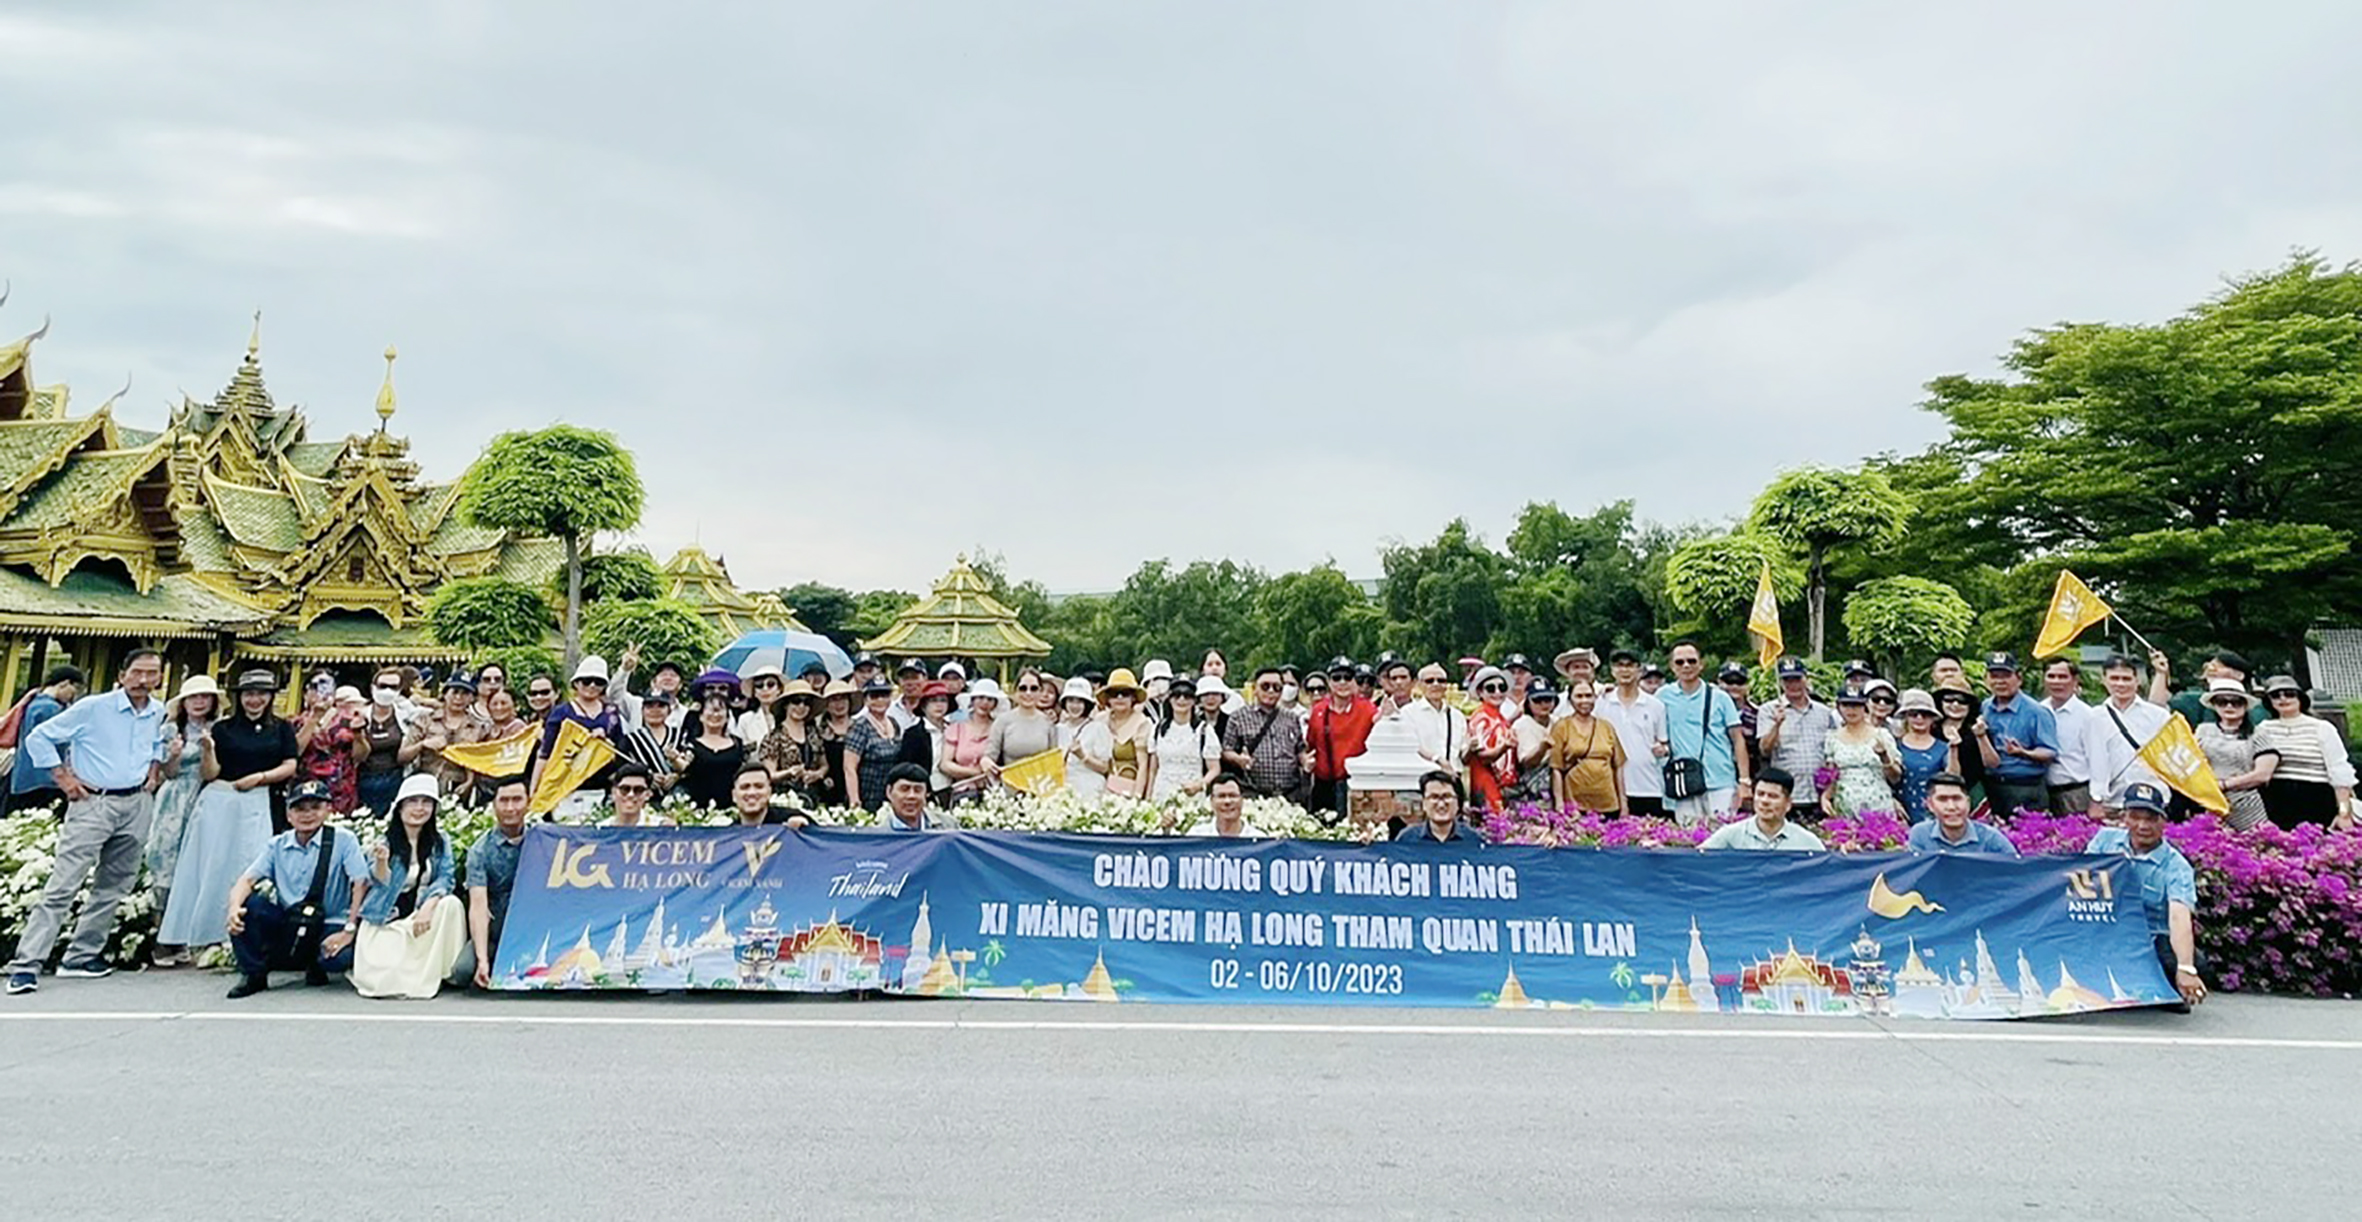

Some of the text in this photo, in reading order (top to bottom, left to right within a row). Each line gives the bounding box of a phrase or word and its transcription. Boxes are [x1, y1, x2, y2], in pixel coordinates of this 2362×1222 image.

[621, 840, 717, 865] VICEM
[622, 871, 712, 892] HẠ LONG
[828, 872, 909, 899] Thailand
[1094, 850, 1517, 899] CHÀO MỪNG QUÝ KHÁCH HÀNG
[979, 899, 1636, 957] XI MĂNG VICEM HẠ LONG THAM QUAN THÁI LAN
[1211, 959, 1239, 988] 02
[1260, 960, 1403, 994] 06/10/2023
